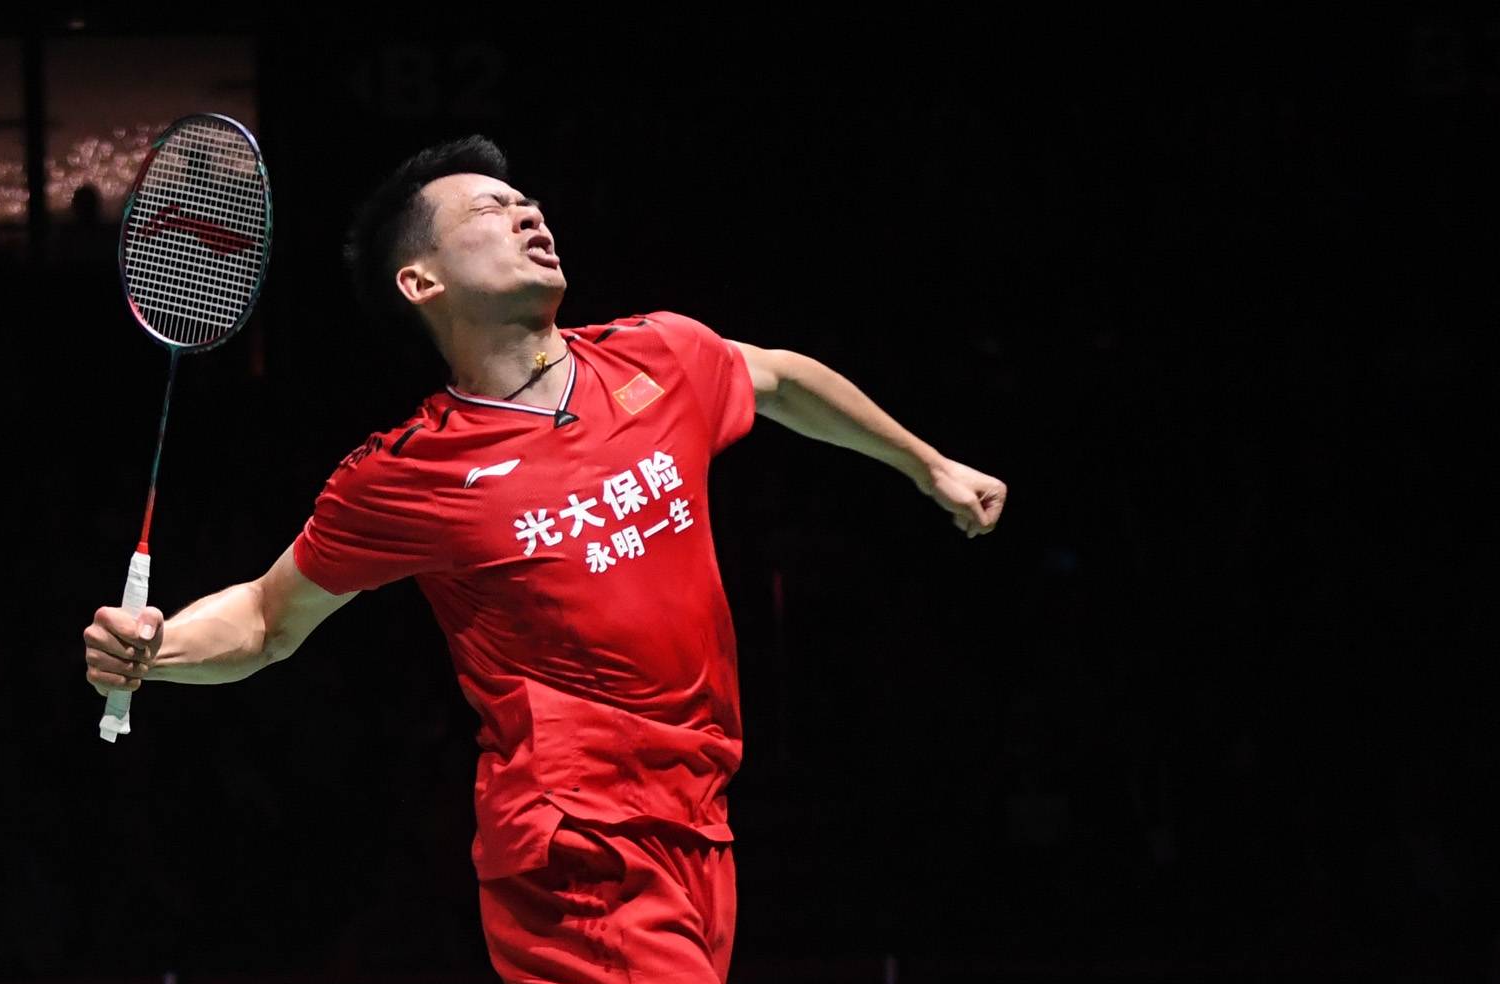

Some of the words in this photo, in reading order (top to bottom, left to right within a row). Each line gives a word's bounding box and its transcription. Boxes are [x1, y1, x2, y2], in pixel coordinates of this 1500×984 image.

[512, 450, 684, 557] 光大保险
[584, 497, 695, 574] 永明一生
